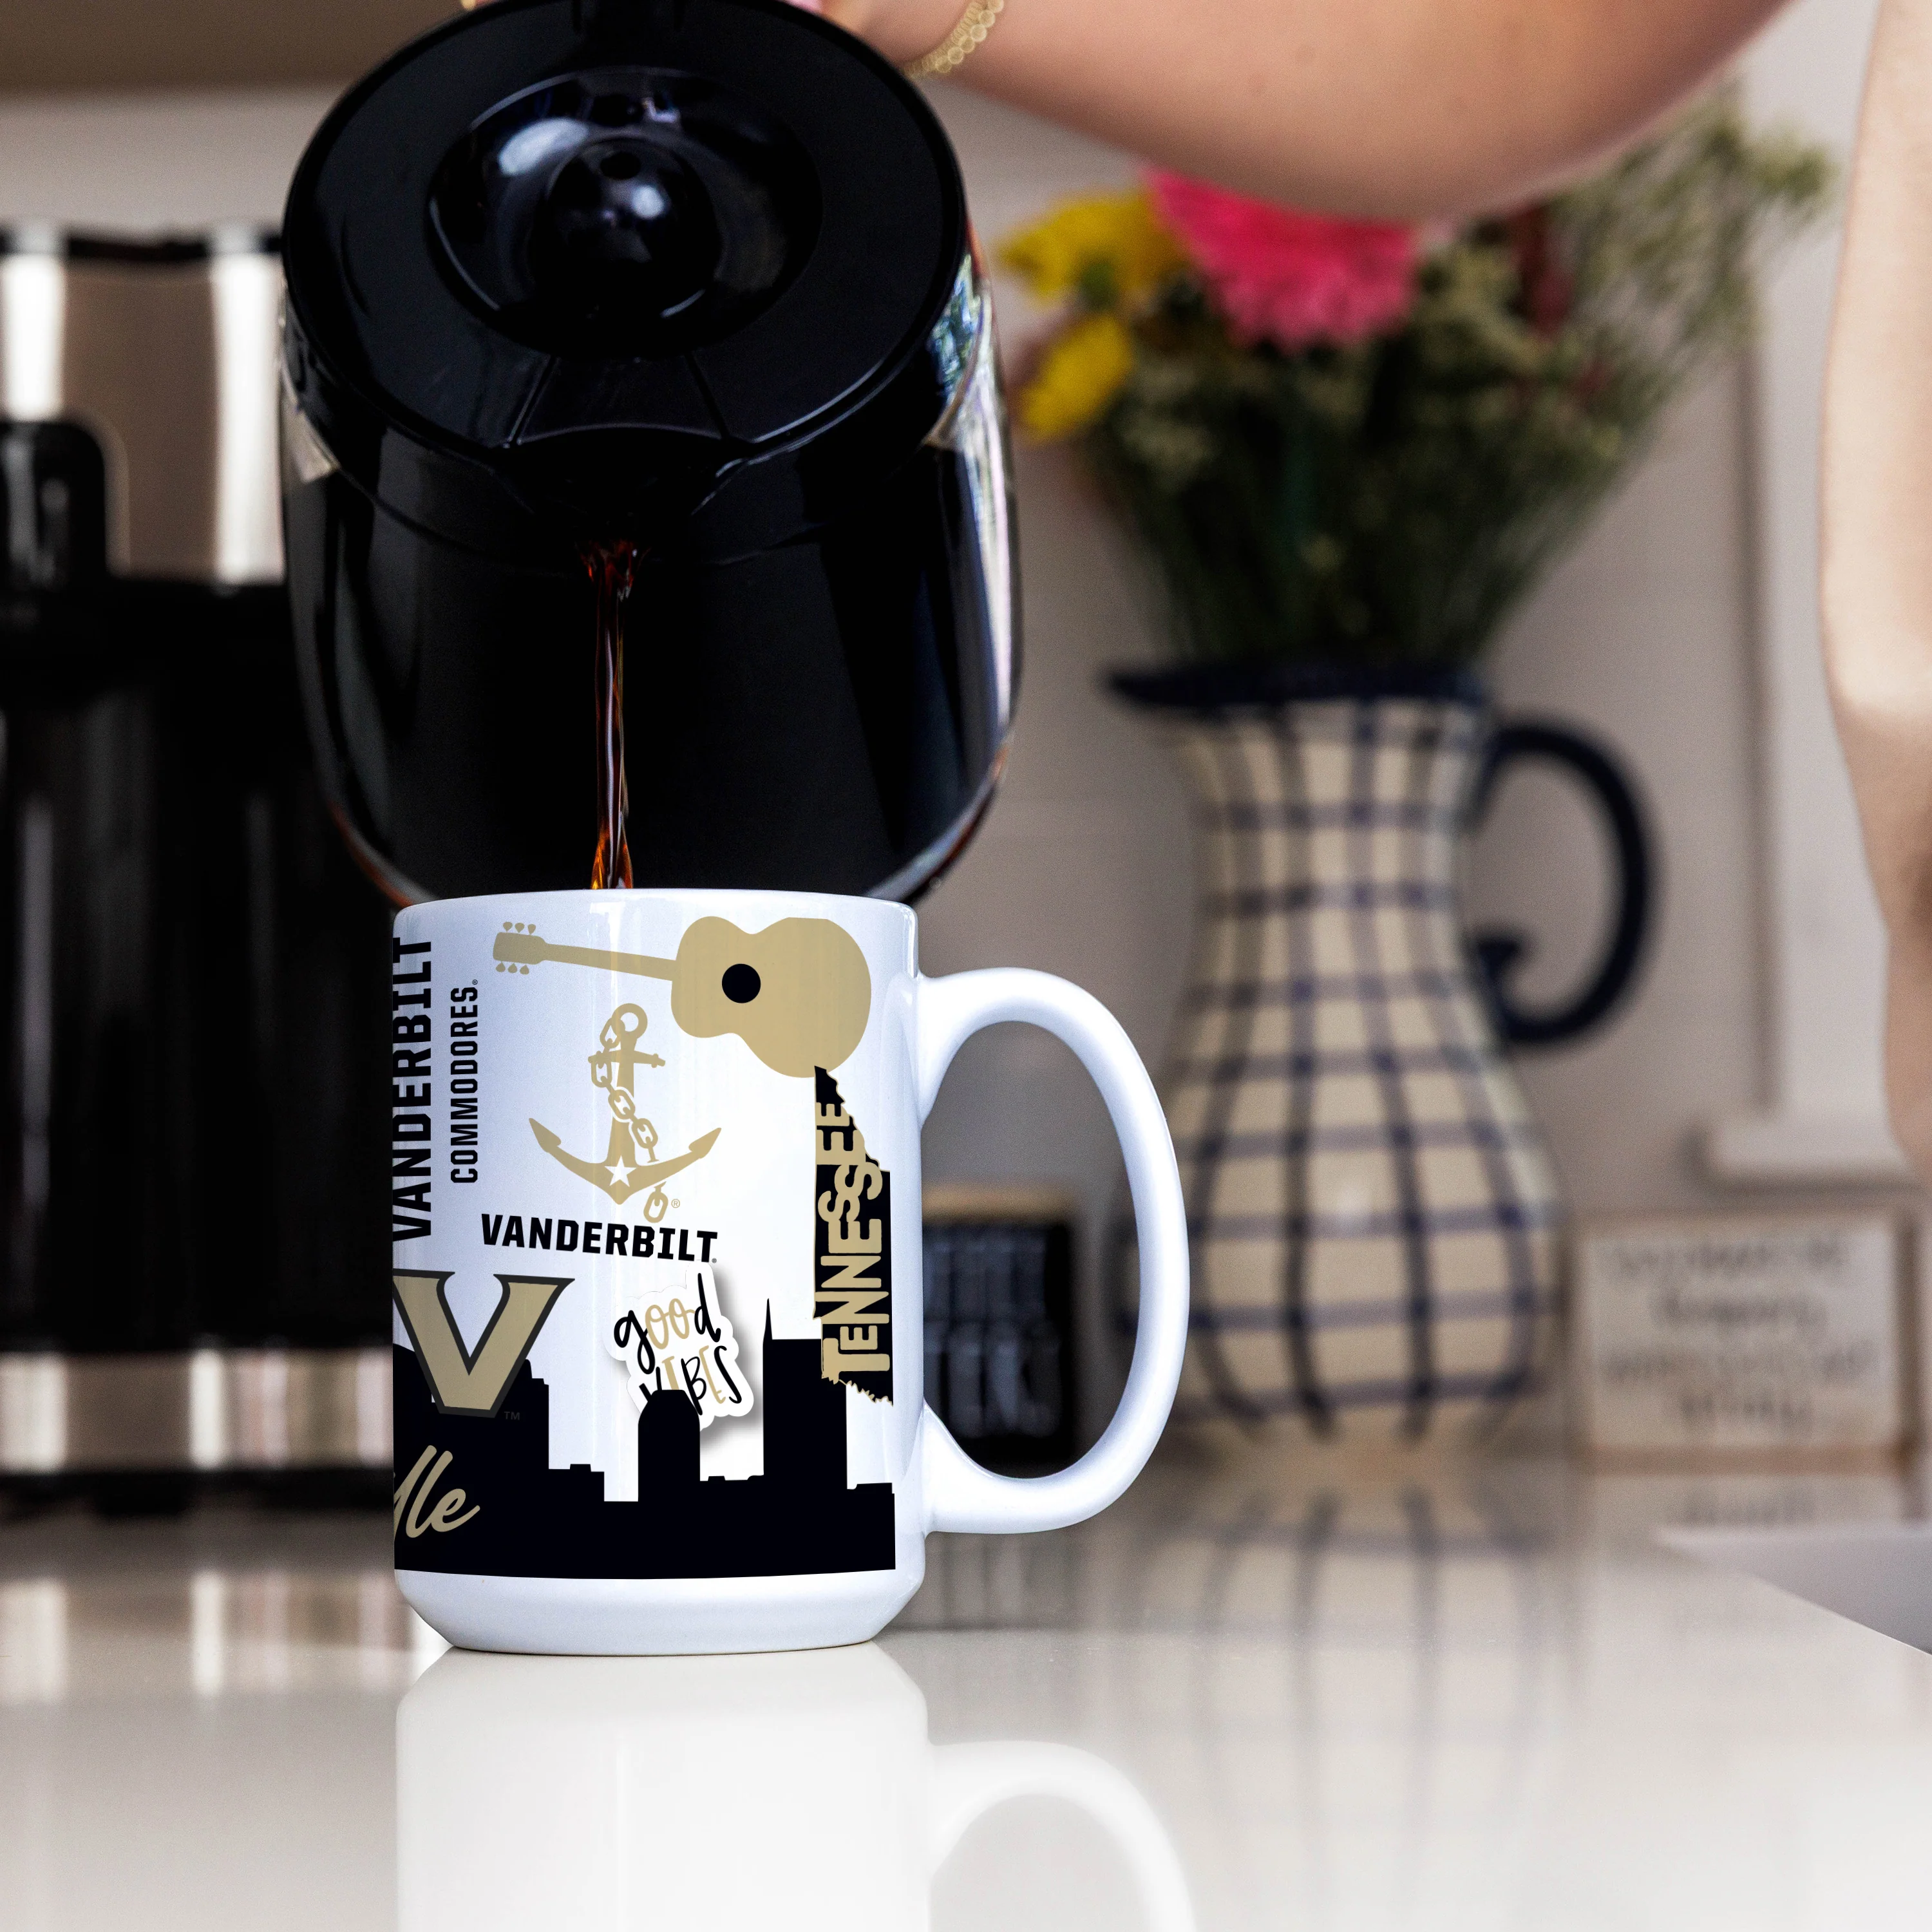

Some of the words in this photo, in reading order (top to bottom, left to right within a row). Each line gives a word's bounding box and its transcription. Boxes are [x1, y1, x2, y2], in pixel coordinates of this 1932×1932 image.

[392, 937, 431, 1242] VANDERBILT
[450, 986, 478, 1184] COMMODORES
[481, 1213, 718, 1263] VANDERBILT
[613, 1273, 721, 1374] good
[815, 1102, 891, 1382] TENNESSEE
